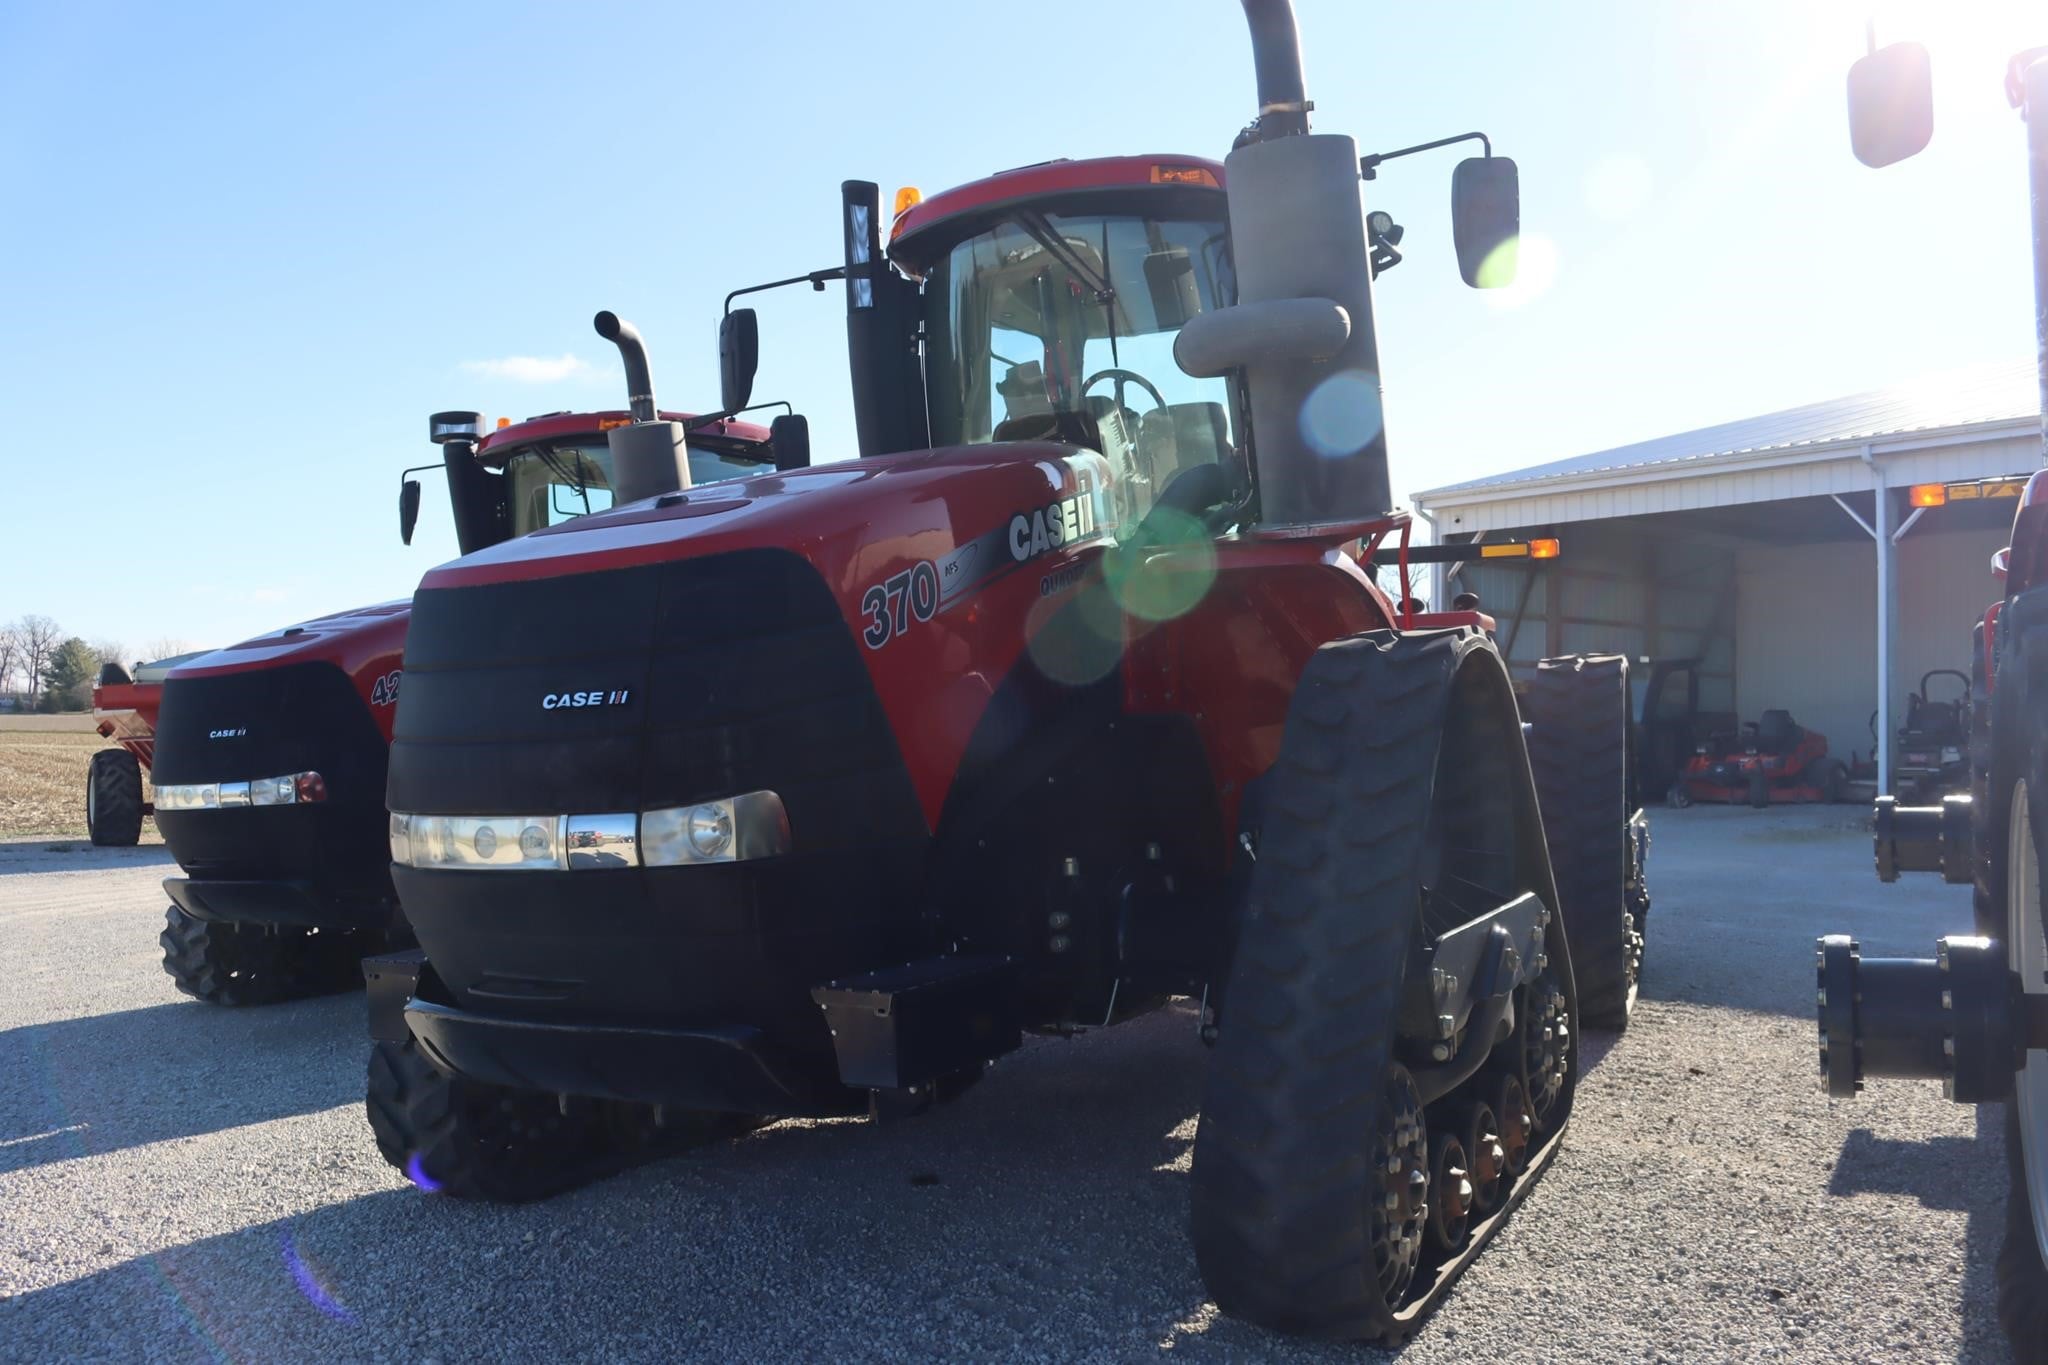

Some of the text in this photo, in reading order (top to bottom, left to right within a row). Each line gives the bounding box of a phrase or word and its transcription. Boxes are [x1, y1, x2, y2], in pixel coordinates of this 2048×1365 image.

[1009, 498, 1078, 562] CASE
[861, 560, 938, 650] 370
[370, 669, 404, 706] 42
[542, 691, 604, 710] CASE
[209, 729, 237, 739] CASE
